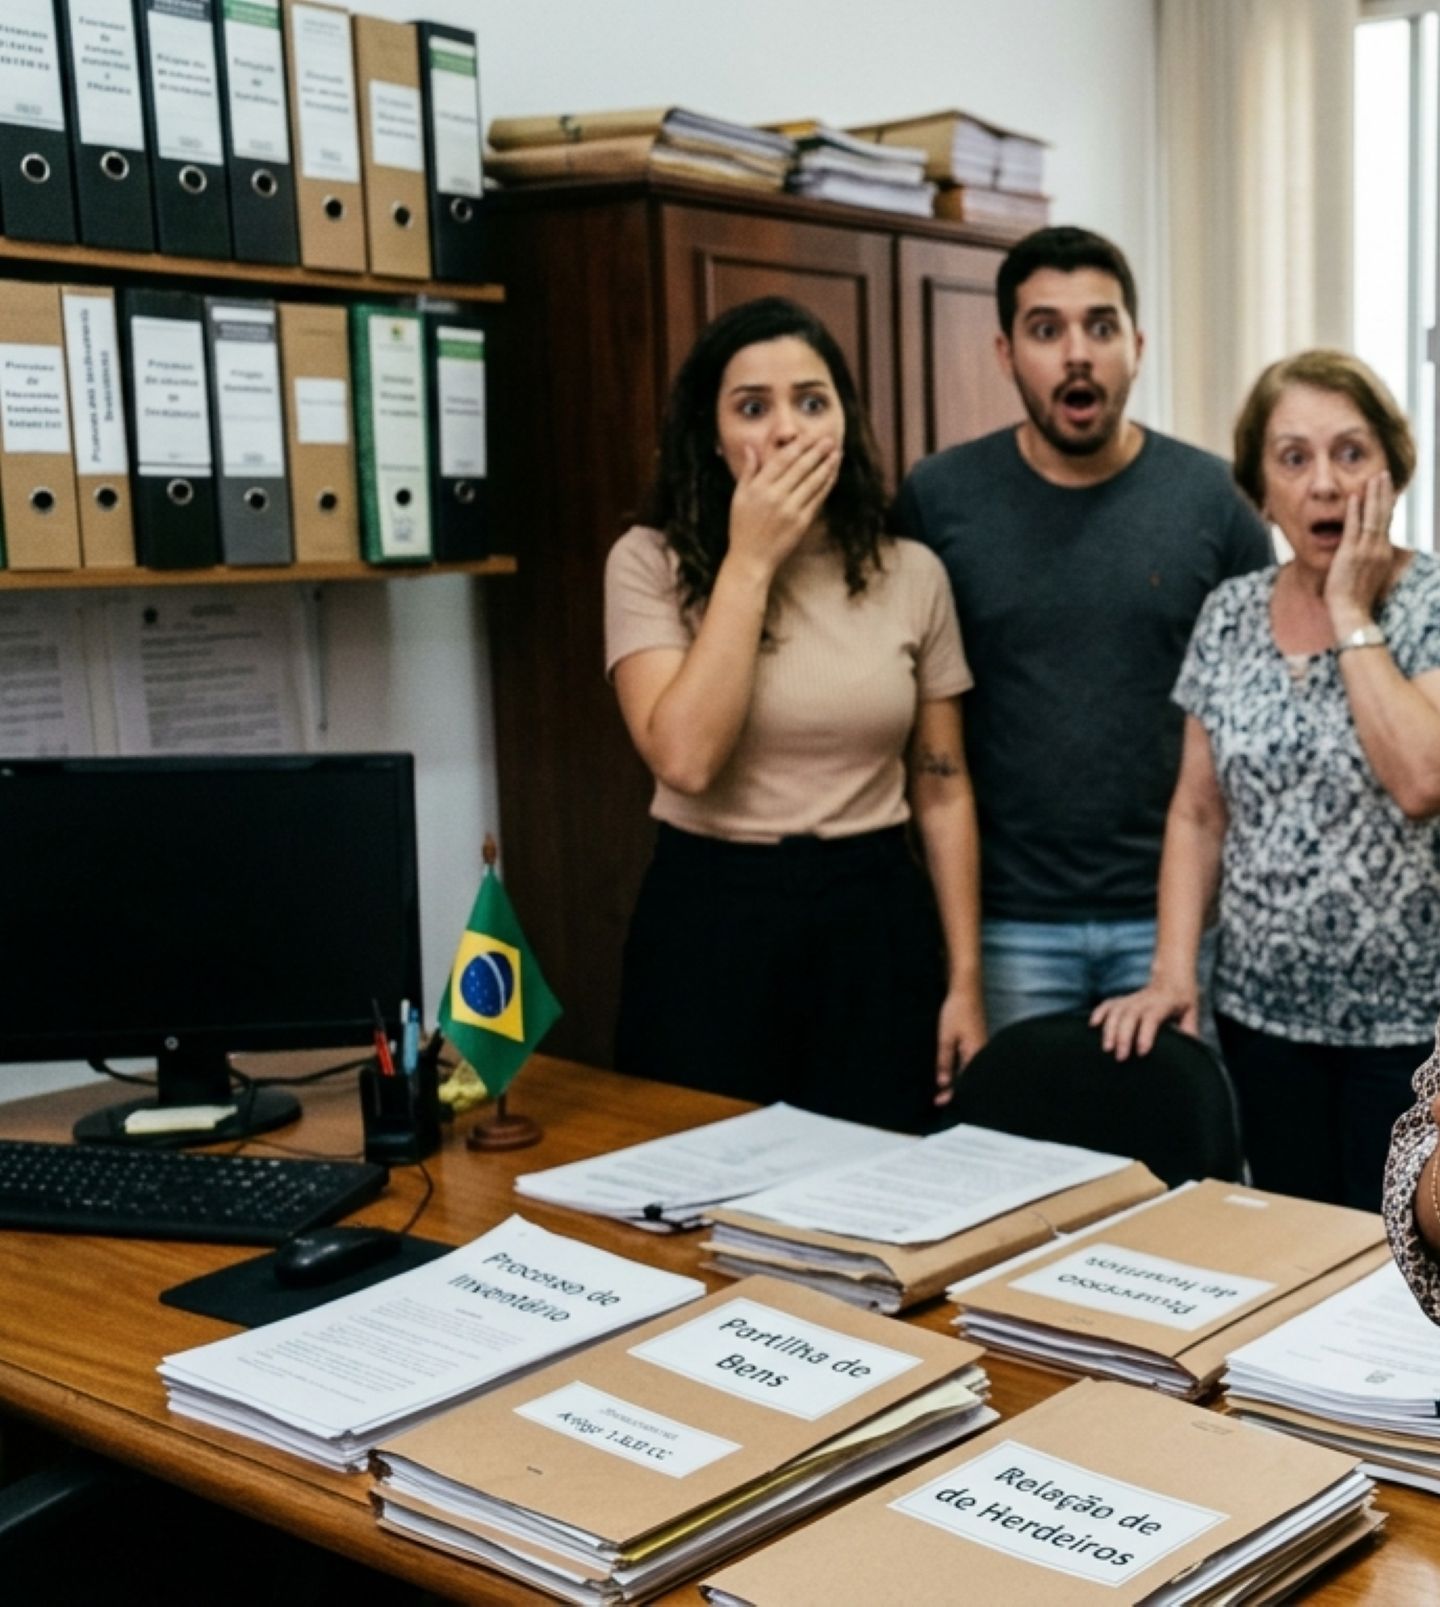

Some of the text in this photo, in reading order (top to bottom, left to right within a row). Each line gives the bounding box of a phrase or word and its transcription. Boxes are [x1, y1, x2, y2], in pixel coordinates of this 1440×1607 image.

[587, 1288, 621, 1306] de
[714, 1352, 790, 1388] Bens
[718, 1317, 871, 1379] Partilha de
[934, 1486, 1136, 1568] de Herdeiros
[993, 1466, 1163, 1537] Relação de
